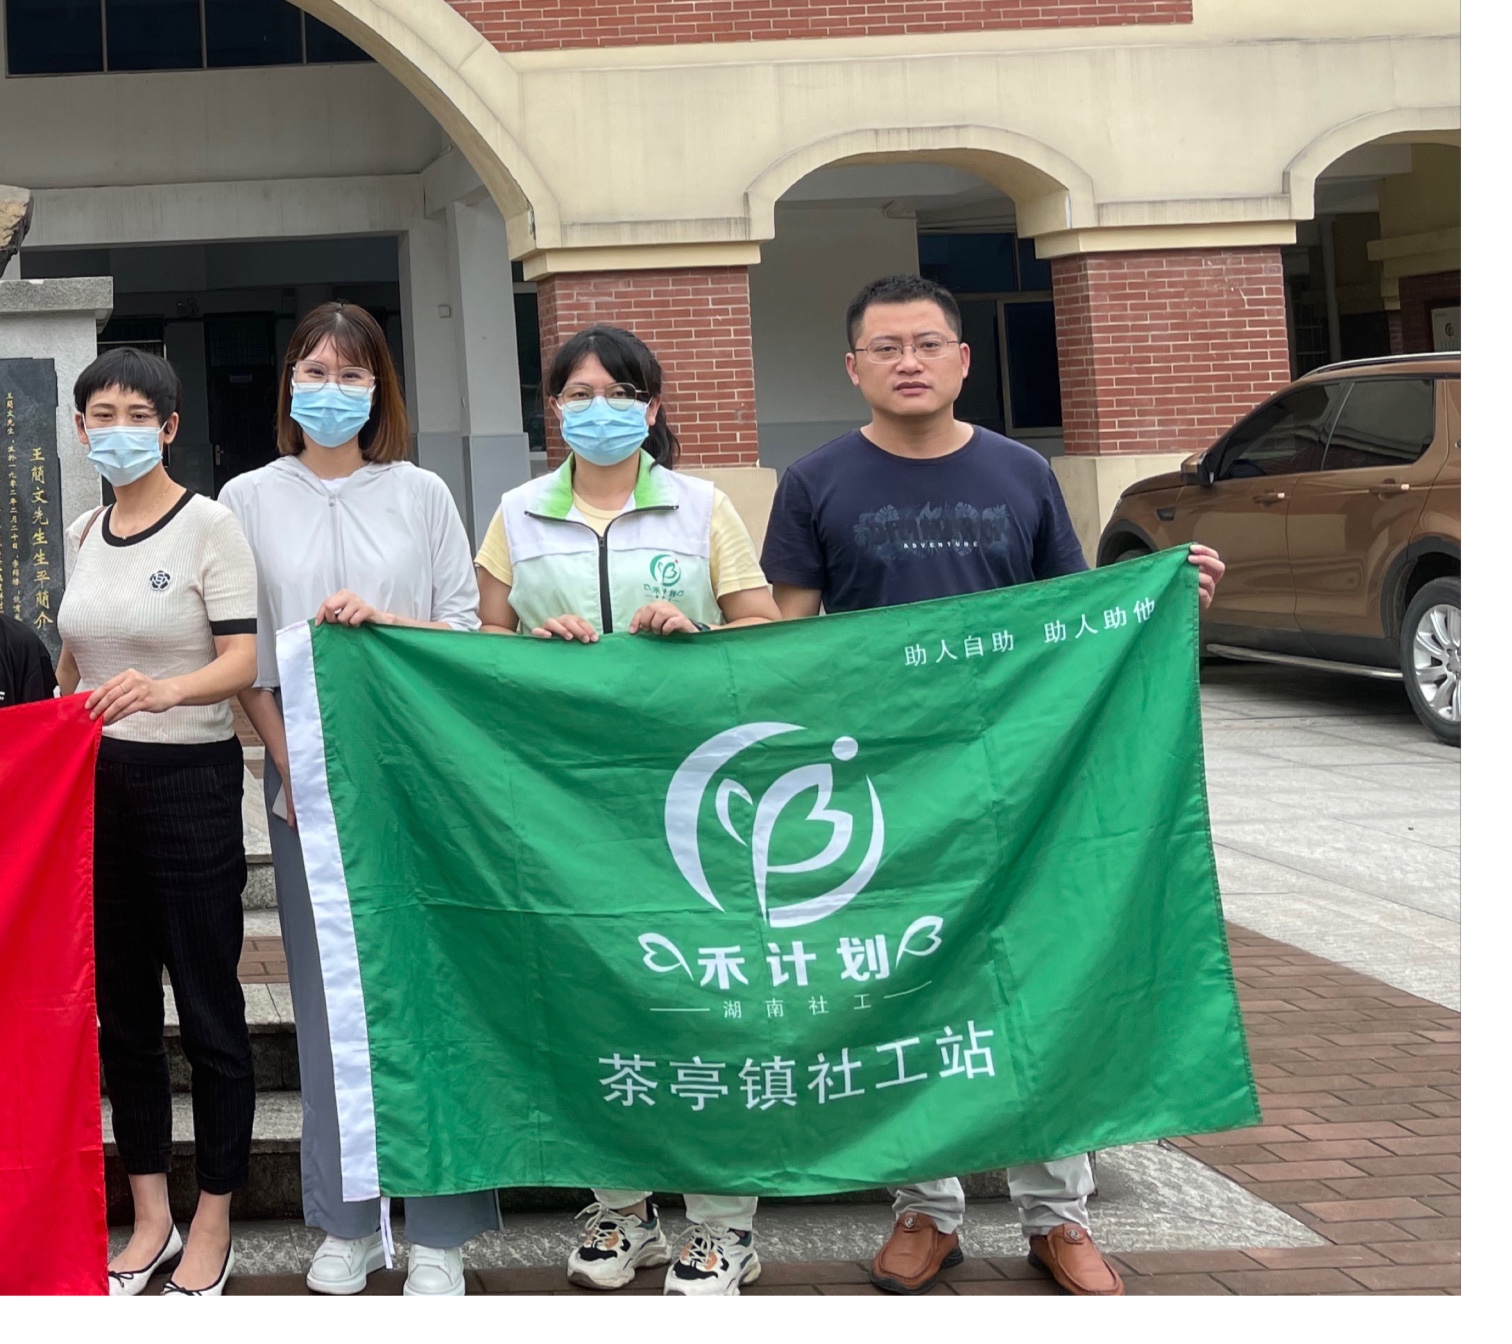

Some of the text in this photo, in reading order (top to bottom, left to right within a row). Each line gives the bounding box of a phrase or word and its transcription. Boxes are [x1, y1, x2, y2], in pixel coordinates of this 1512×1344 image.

[30, 447, 53, 629] 王簡文先生生平簡介
[903, 541, 978, 549] ADVENTURE
[905, 596, 1155, 666] 助人自助 助人助他
[697, 934, 889, 989] 禾计划
[723, 993, 872, 1019] 湖南社工
[598, 1020, 996, 1111] 茶亭镇社工站
